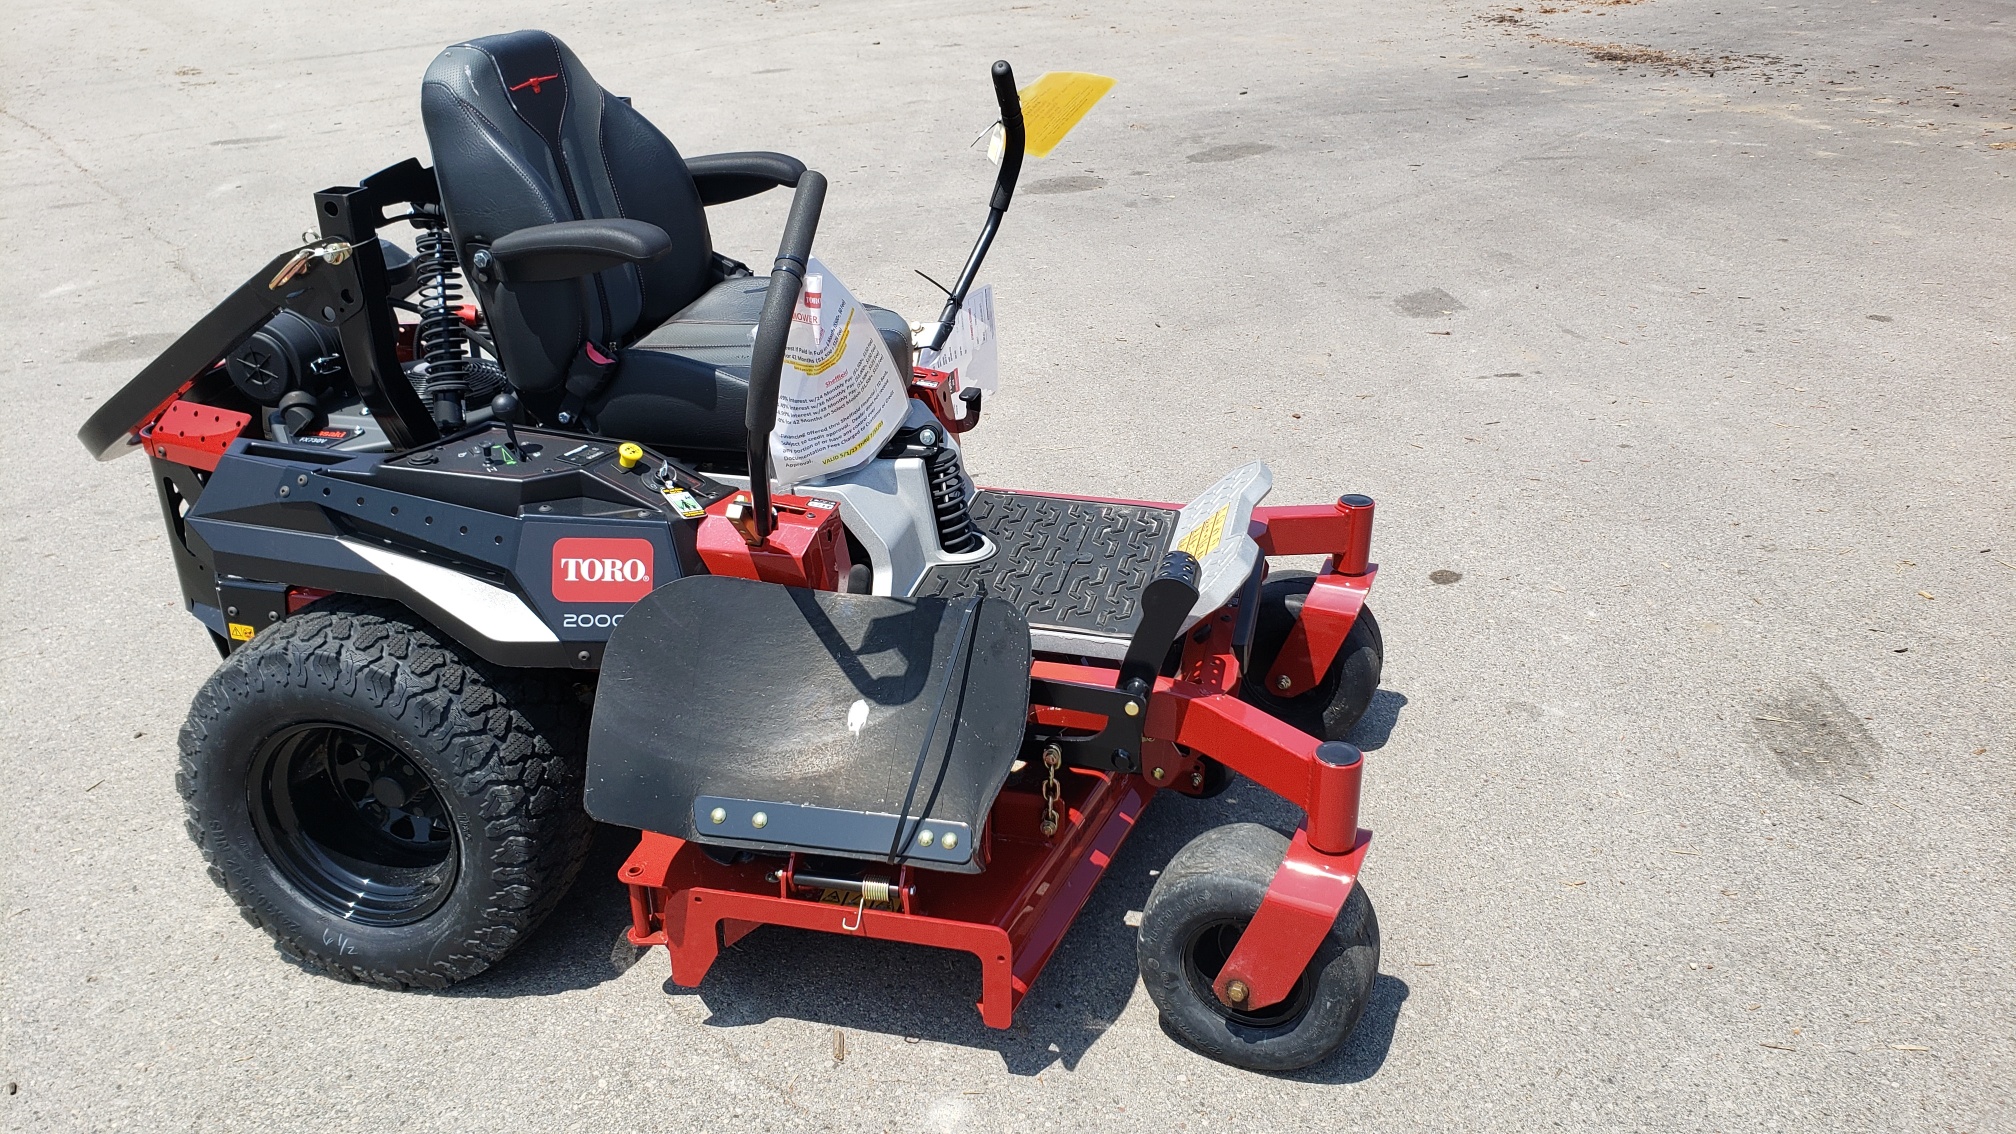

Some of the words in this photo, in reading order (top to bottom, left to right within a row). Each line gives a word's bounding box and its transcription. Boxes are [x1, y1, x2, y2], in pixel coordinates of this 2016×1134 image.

[825, 368, 848, 388] Sheffield
[806, 427, 828, 436] offered
[840, 407, 860, 423] Sheffield
[784, 446, 826, 461] Documentation
[841, 430, 860, 445] Charged
[794, 444, 814, 454] portion
[786, 459, 814, 468] Approval.
[822, 455, 840, 465] VALID
[560, 558, 646, 582] TORO
